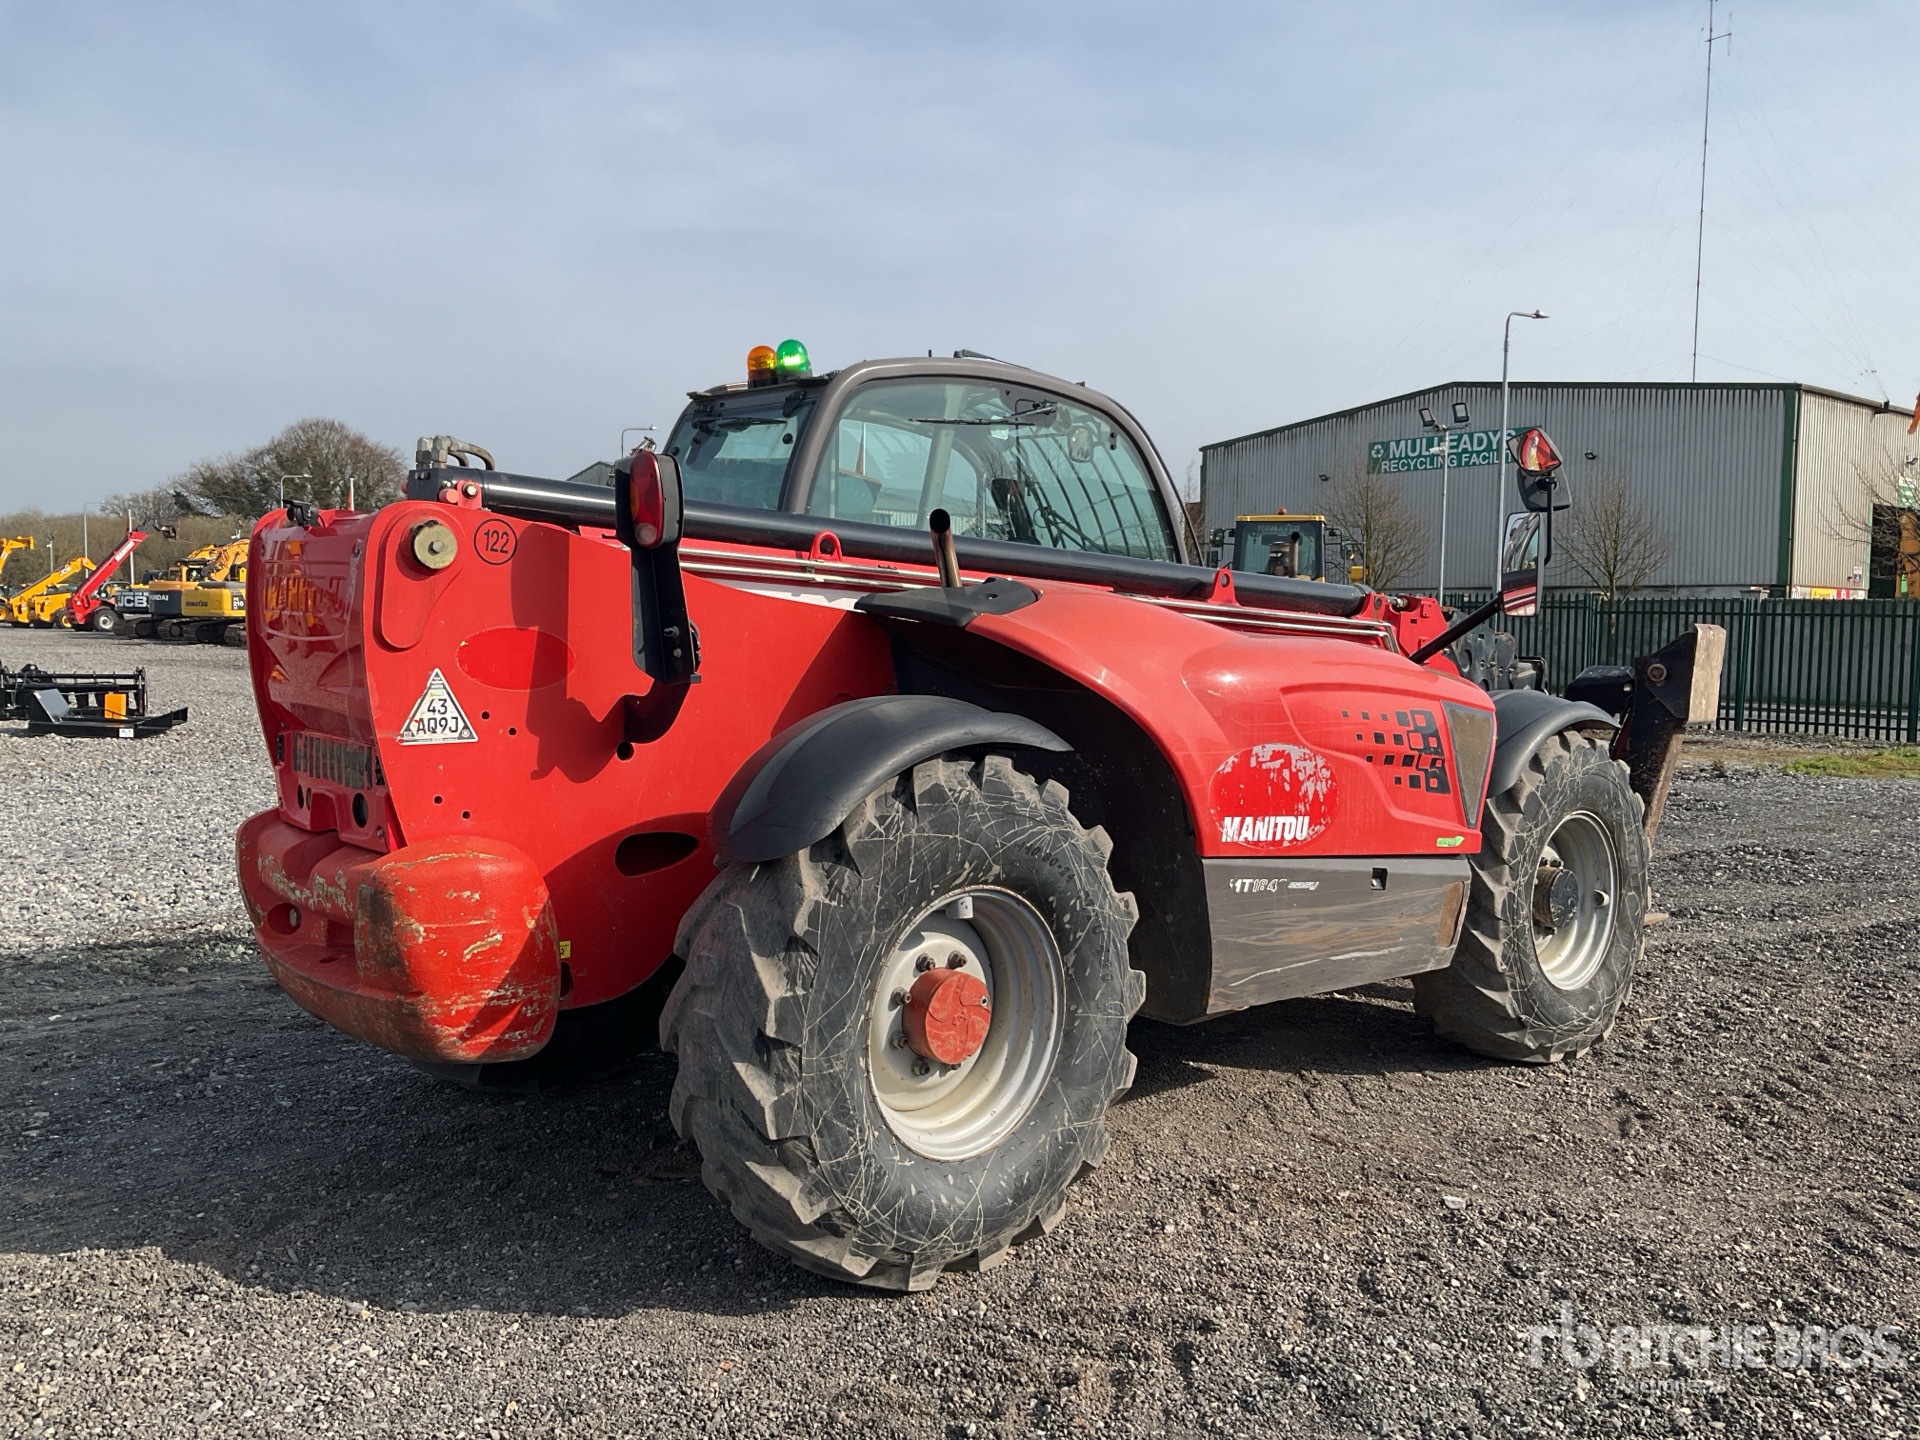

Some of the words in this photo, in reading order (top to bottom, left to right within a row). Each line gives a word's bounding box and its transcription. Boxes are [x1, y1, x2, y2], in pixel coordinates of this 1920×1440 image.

[1381, 455, 1457, 473] RECYCLING
[1461, 449, 1512, 468] FACILT
[483, 529, 510, 554] 122
[117, 595, 148, 608] JCB
[427, 698, 448, 715] 43
[416, 716, 459, 735] AQ9J
[1221, 816, 1310, 842] MANITOU
